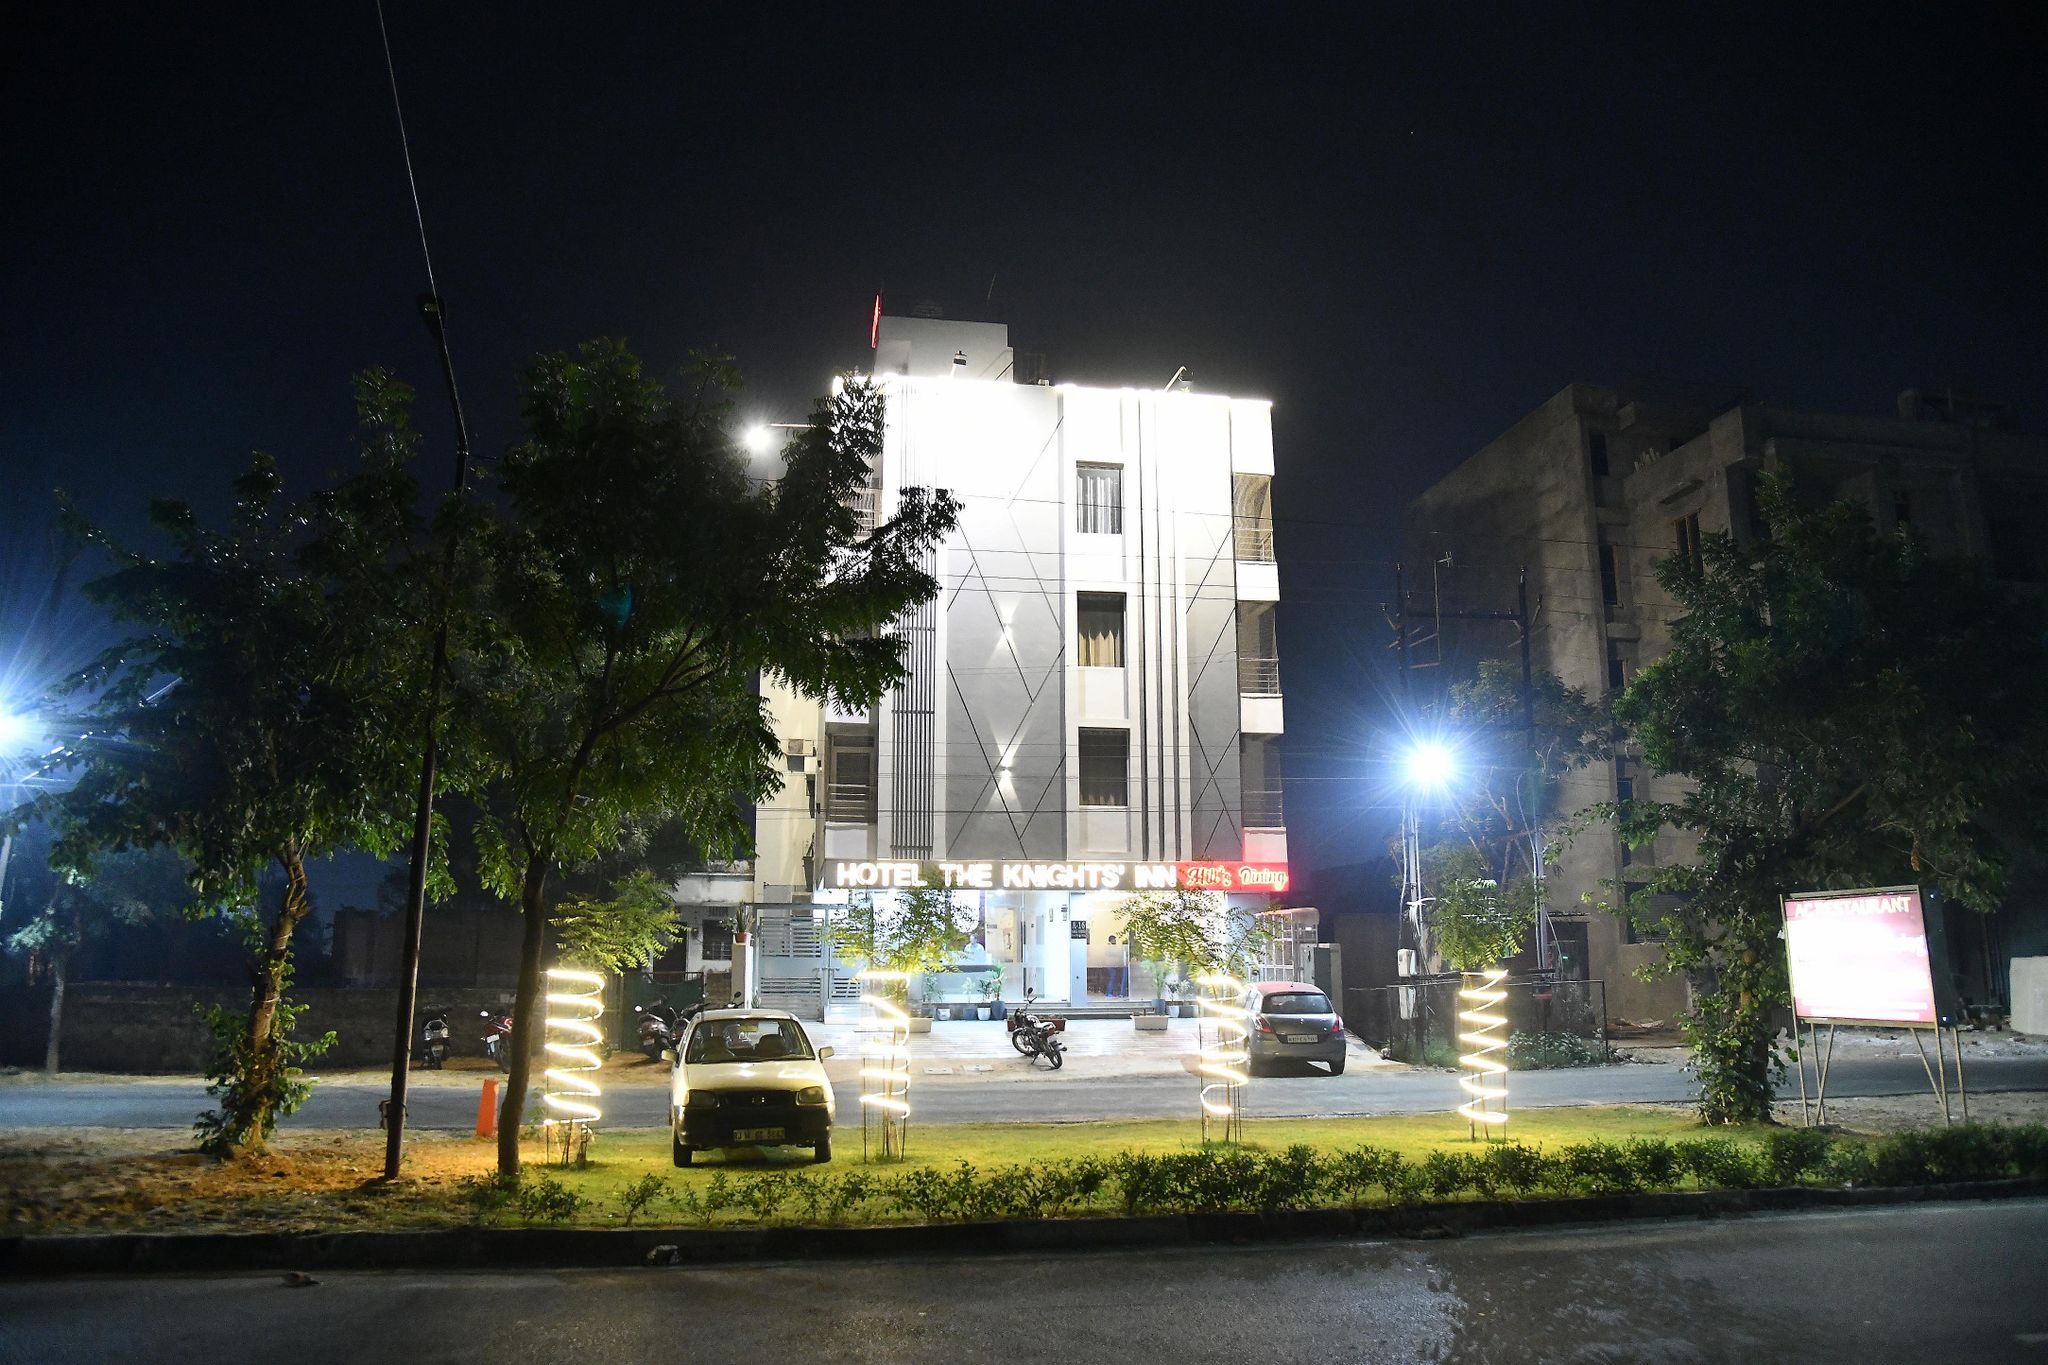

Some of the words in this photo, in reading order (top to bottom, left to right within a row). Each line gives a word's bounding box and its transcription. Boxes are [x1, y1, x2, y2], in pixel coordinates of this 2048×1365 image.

[836, 862, 928, 888] HOTEL
[939, 863, 993, 888] THE
[1002, 864, 1126, 888] KNIGHTS'
[1134, 864, 1178, 888] INN
[1238, 866, 1289, 891] Dining
[1795, 902, 1816, 918] AC
